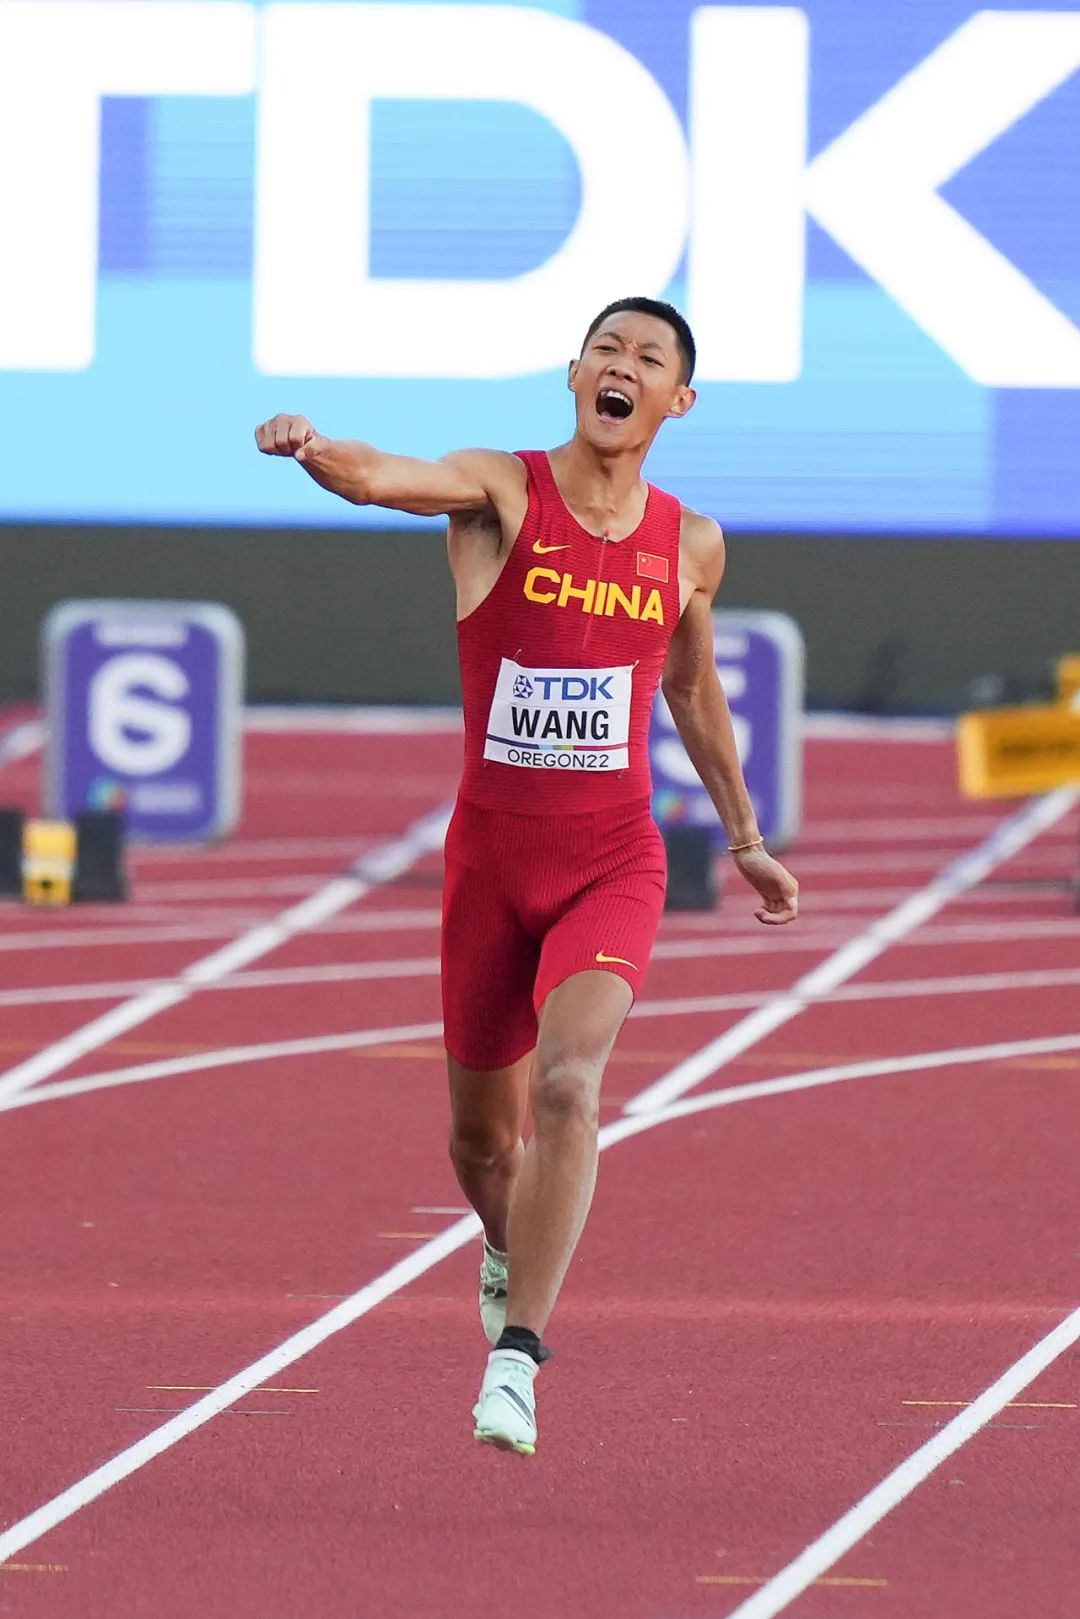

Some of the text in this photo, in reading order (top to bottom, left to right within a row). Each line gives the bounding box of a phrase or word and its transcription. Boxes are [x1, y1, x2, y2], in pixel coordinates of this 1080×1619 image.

[0, 0, 1080, 389] TDK
[523, 566, 664, 626] CHINA
[534, 676, 614, 700] TDK
[88, 652, 191, 776] 6
[511, 706, 609, 740] WANG
[507, 749, 609, 768] OREGON22
